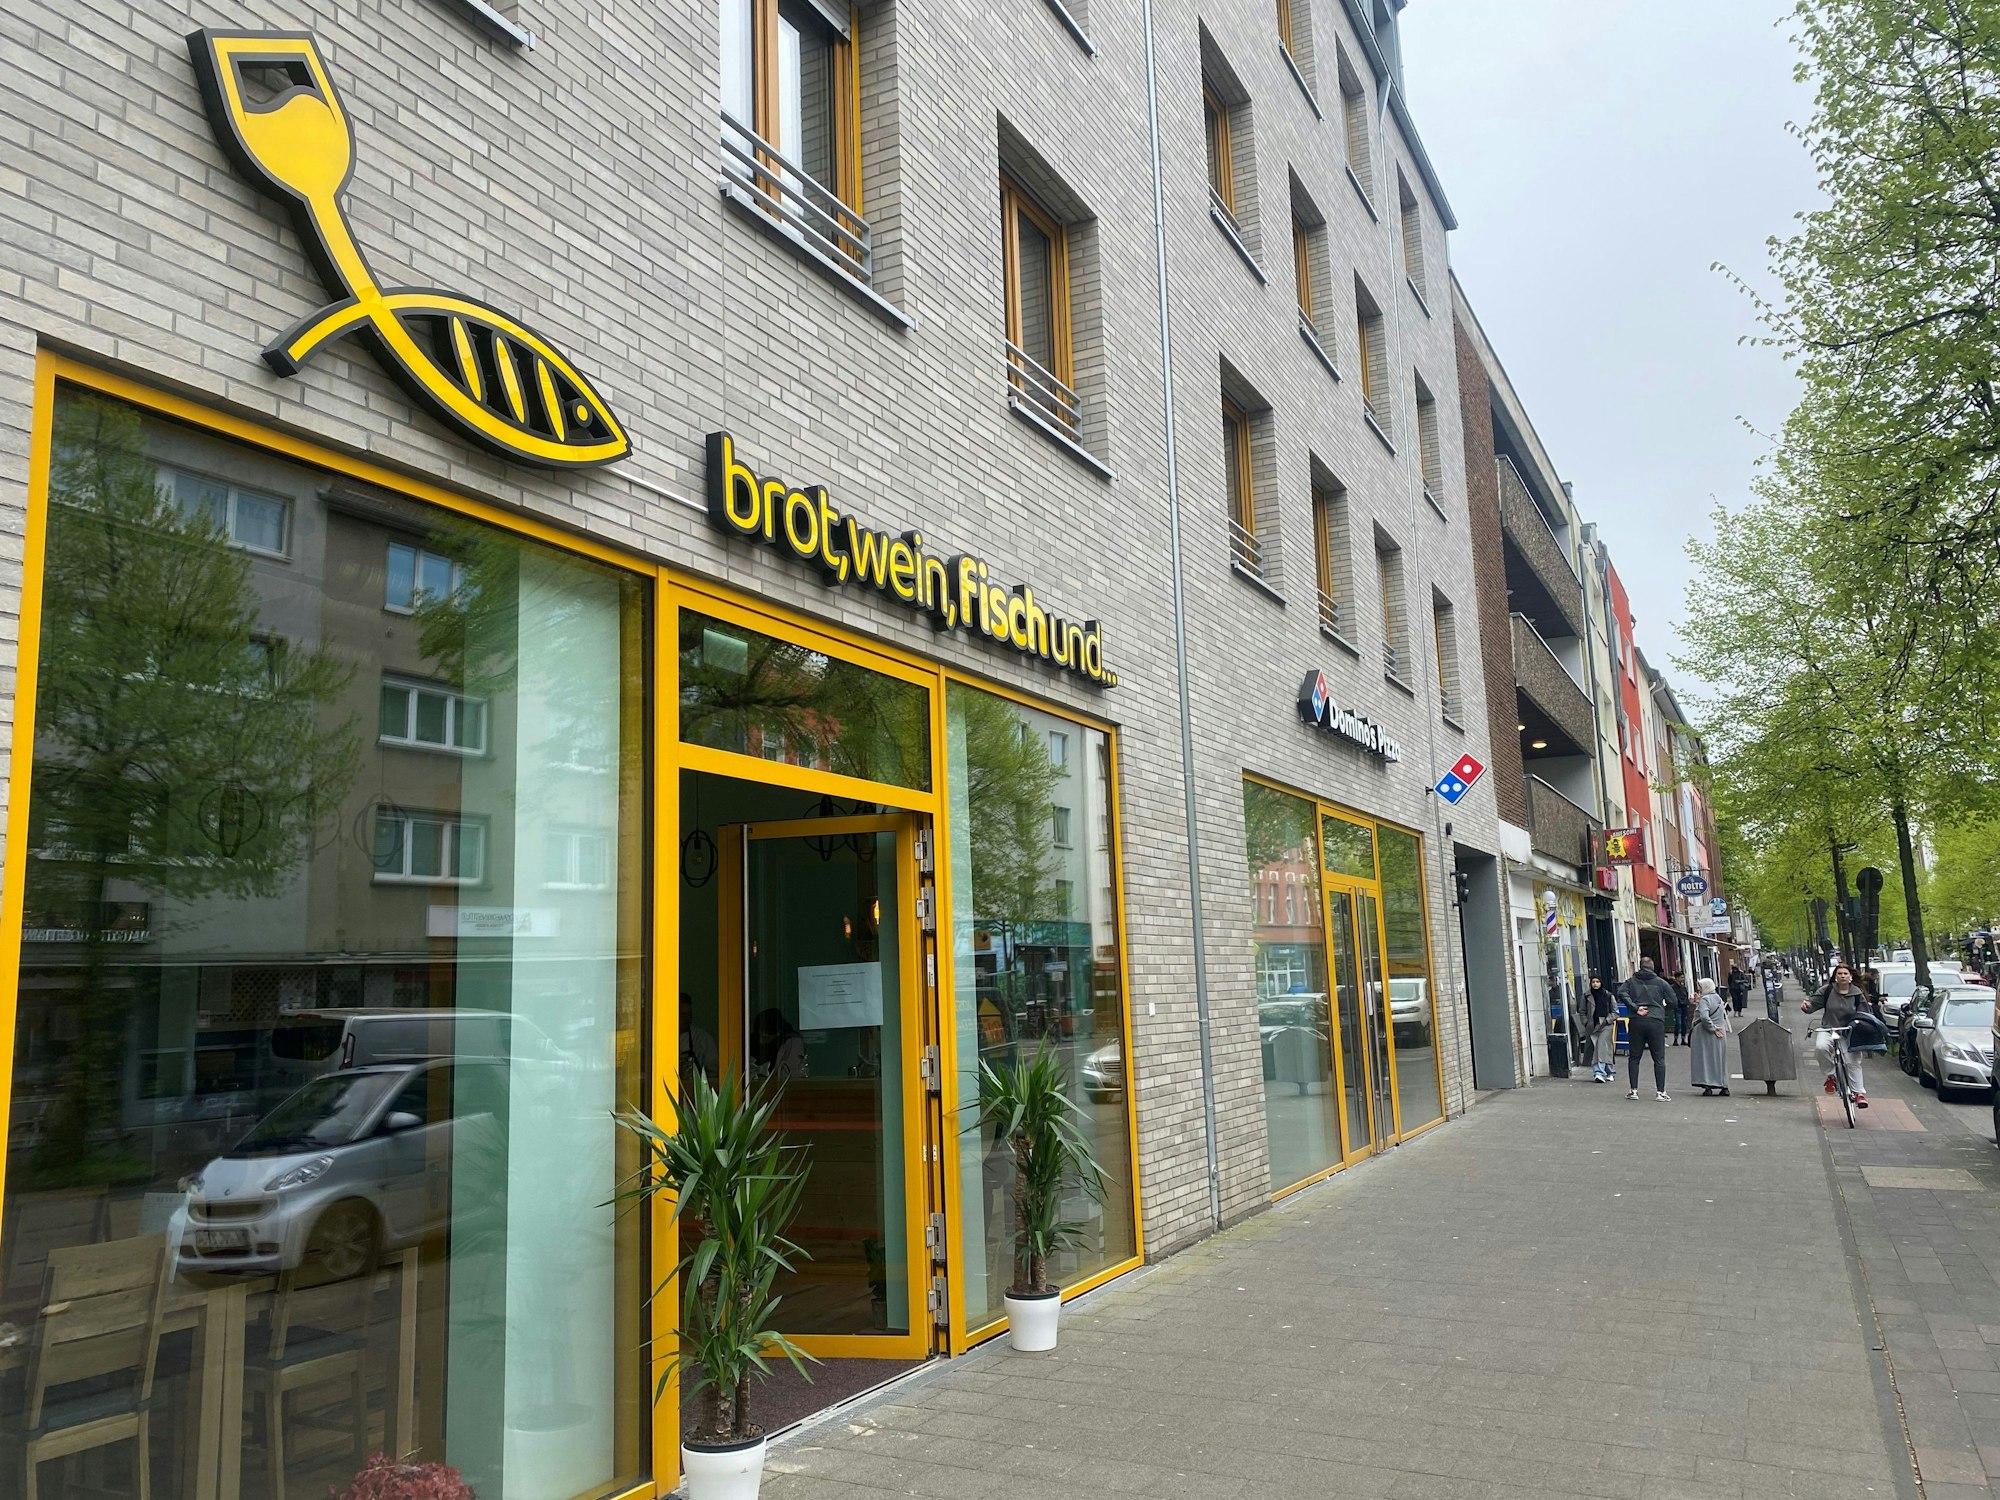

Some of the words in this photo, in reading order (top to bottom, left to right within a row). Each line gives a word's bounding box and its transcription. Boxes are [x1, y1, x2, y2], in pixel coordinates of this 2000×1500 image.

[1328, 696, 1377, 751] Domino's
[1377, 724, 1402, 763] Pizza
[1681, 881, 1704, 891] NOLTE
